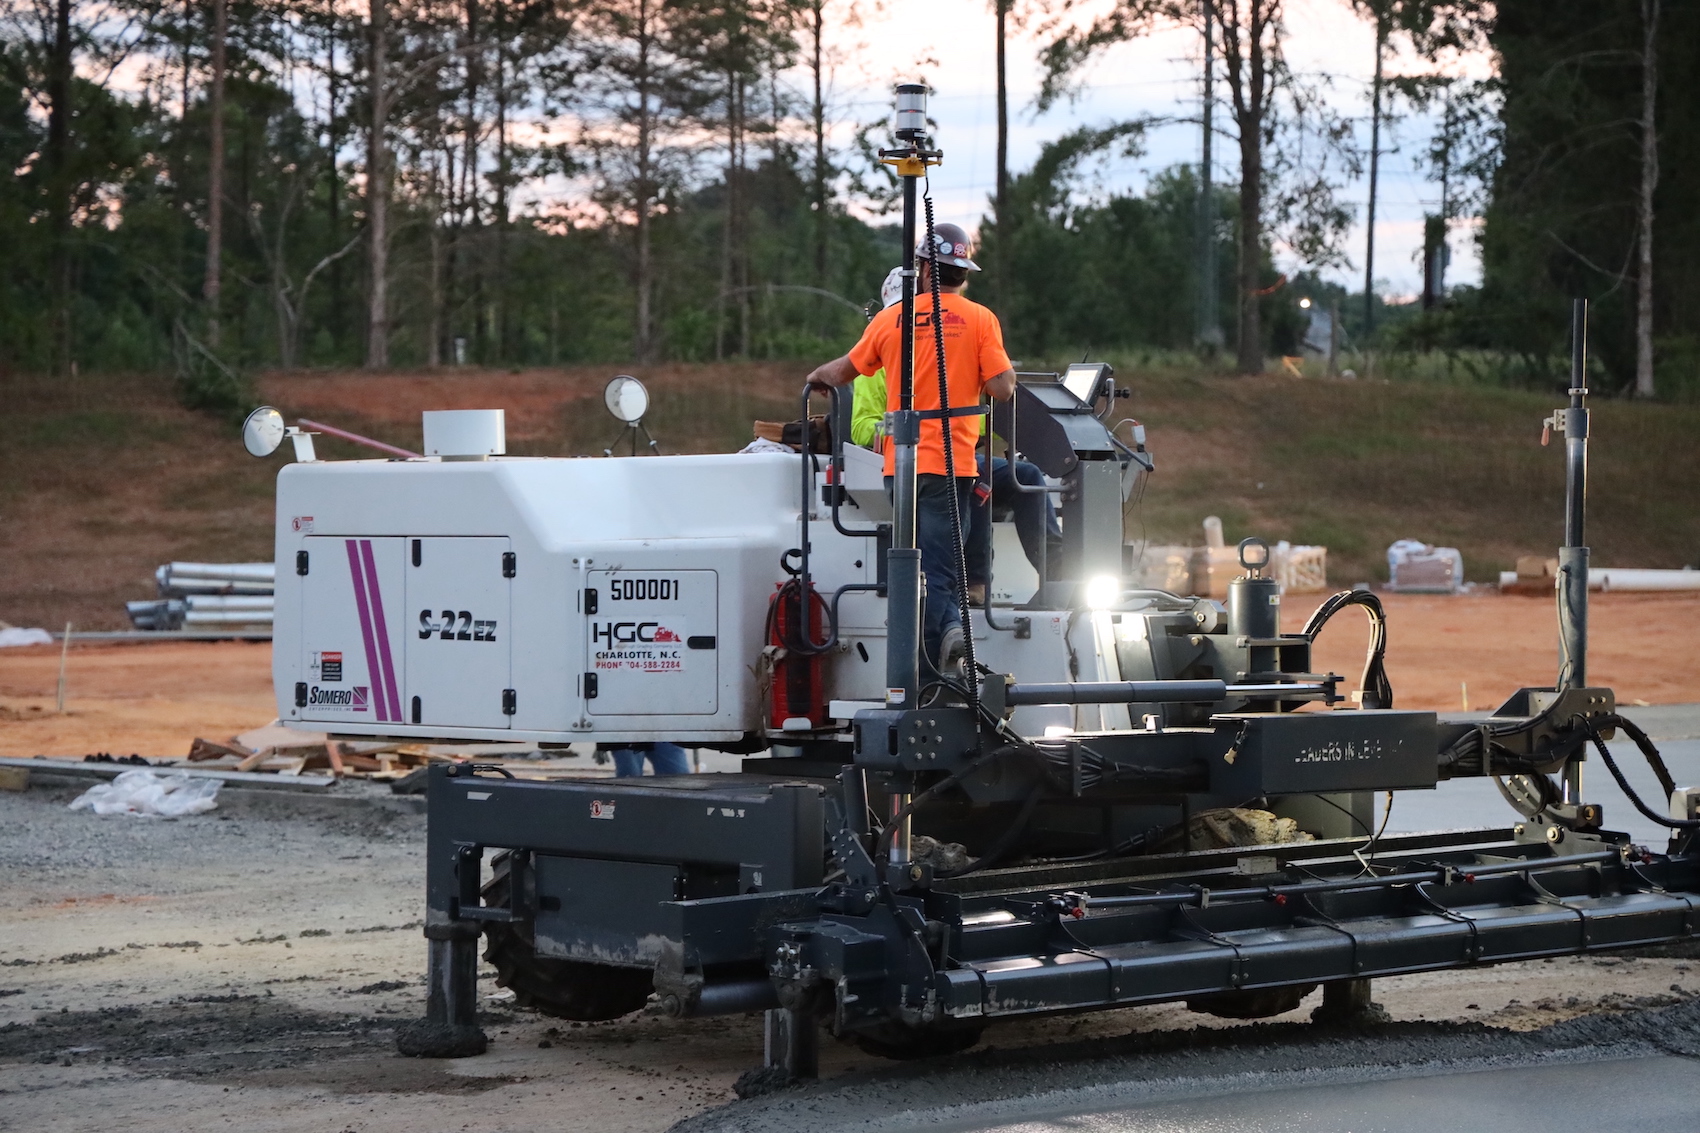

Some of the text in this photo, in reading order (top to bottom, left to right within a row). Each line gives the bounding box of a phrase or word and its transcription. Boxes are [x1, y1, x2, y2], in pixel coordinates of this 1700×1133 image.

[611, 579, 679, 601] 500001
[418, 609, 497, 642] S-22EZ
[593, 622, 658, 650] HGC
[595, 650, 681, 660] CHARLOTTE, N.C.
[626, 661, 681, 669] 04-588-2284
